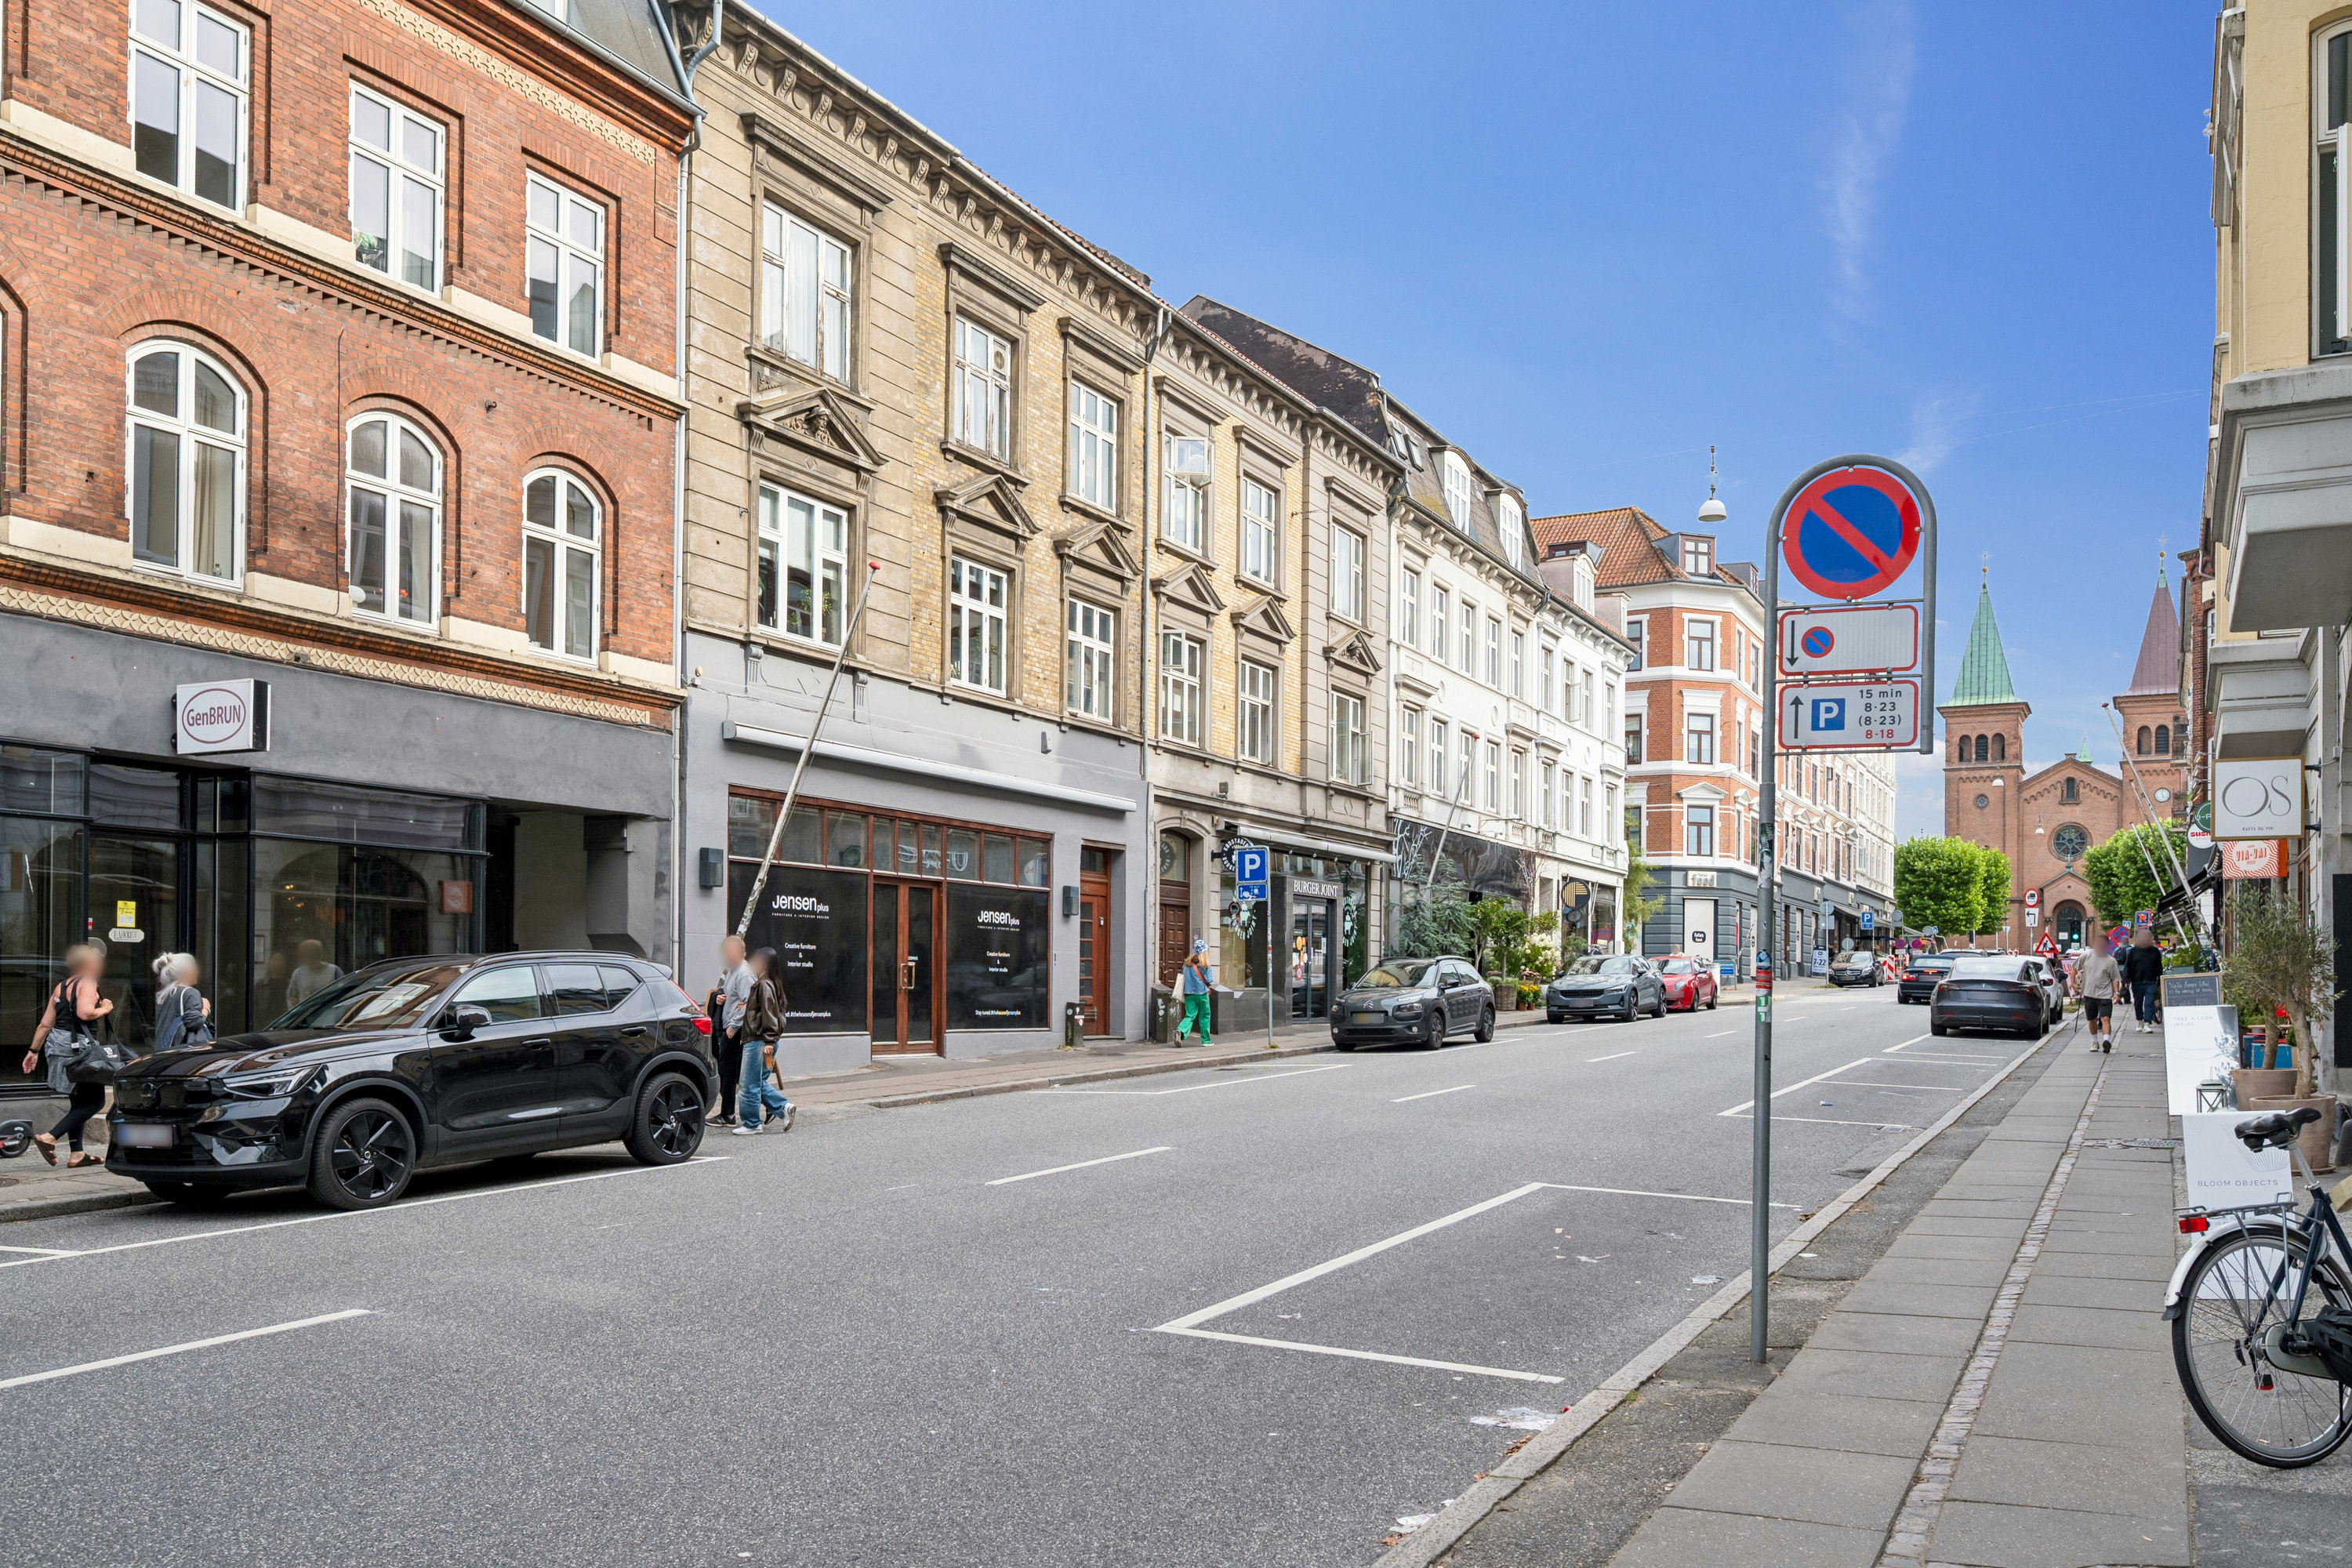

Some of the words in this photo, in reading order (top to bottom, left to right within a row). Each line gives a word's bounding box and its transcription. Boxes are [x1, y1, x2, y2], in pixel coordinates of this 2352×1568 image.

[1859, 689, 1873, 699] 15
[1878, 688, 1902, 699] min
[187, 704, 241, 727] GenBRUN
[1819, 702, 1839, 728] P
[1864, 702, 1896, 713] 8-23
[1858, 714, 1902, 727] (8-23)
[1865, 729, 1895, 739] 8-18
[2222, 775, 2292, 818] OS
[1222, 856, 1236, 872] BURGE
[1244, 853, 1261, 879] P
[1294, 880, 1319, 895] BURGER
[1320, 884, 1338, 898] JOINT
[1864, 913, 1871, 923] P
